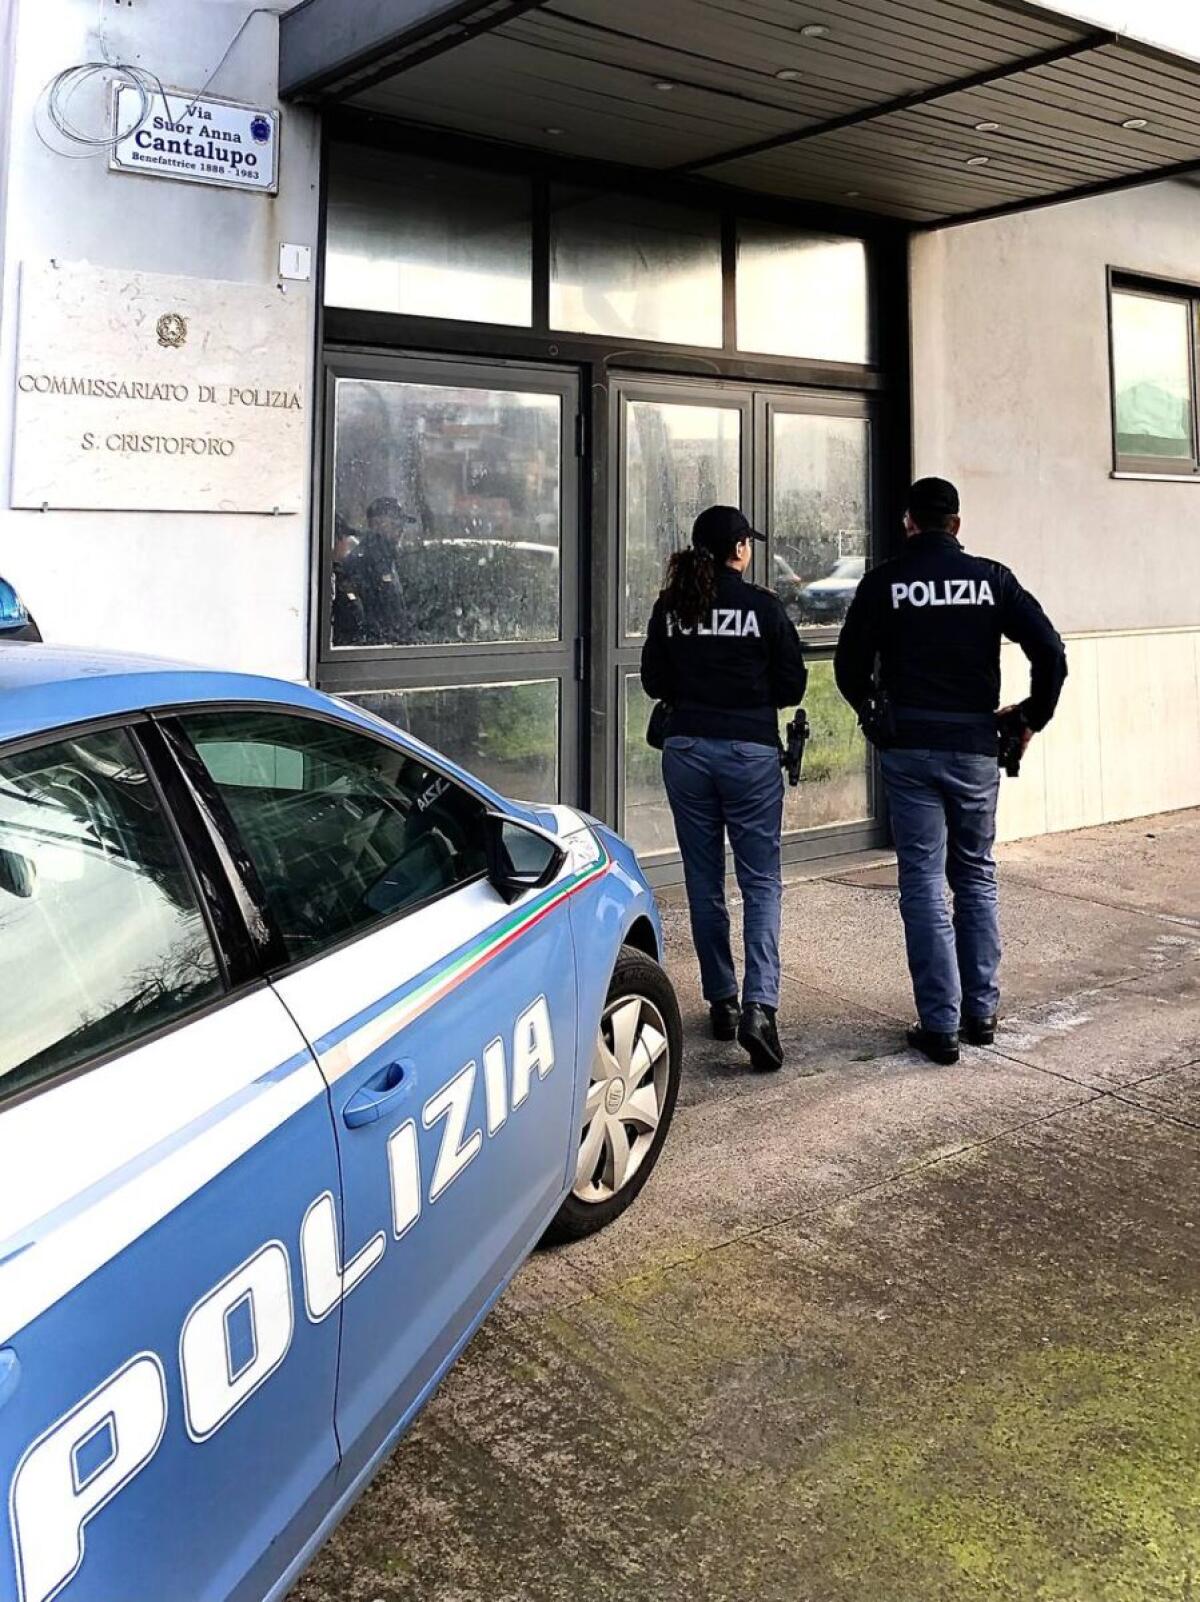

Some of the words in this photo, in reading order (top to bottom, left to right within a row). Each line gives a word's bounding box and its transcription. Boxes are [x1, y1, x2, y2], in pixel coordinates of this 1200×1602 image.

[186, 105, 212, 120] Via
[153, 116, 193, 135] Suor
[199, 125, 242, 143] Anna
[132, 152, 196, 170] Benefattrice
[135, 130, 258, 168] Cantalupo
[18, 374, 188, 401] COMMISSARIATO
[198, 386, 216, 403] DI
[228, 388, 303, 410] POLIZIA
[81, 432, 100, 451] S.
[106, 433, 236, 457] CRISTOFORO
[891, 579, 995, 609] POLIZIA
[8, 992, 556, 1602] POLIZIA
